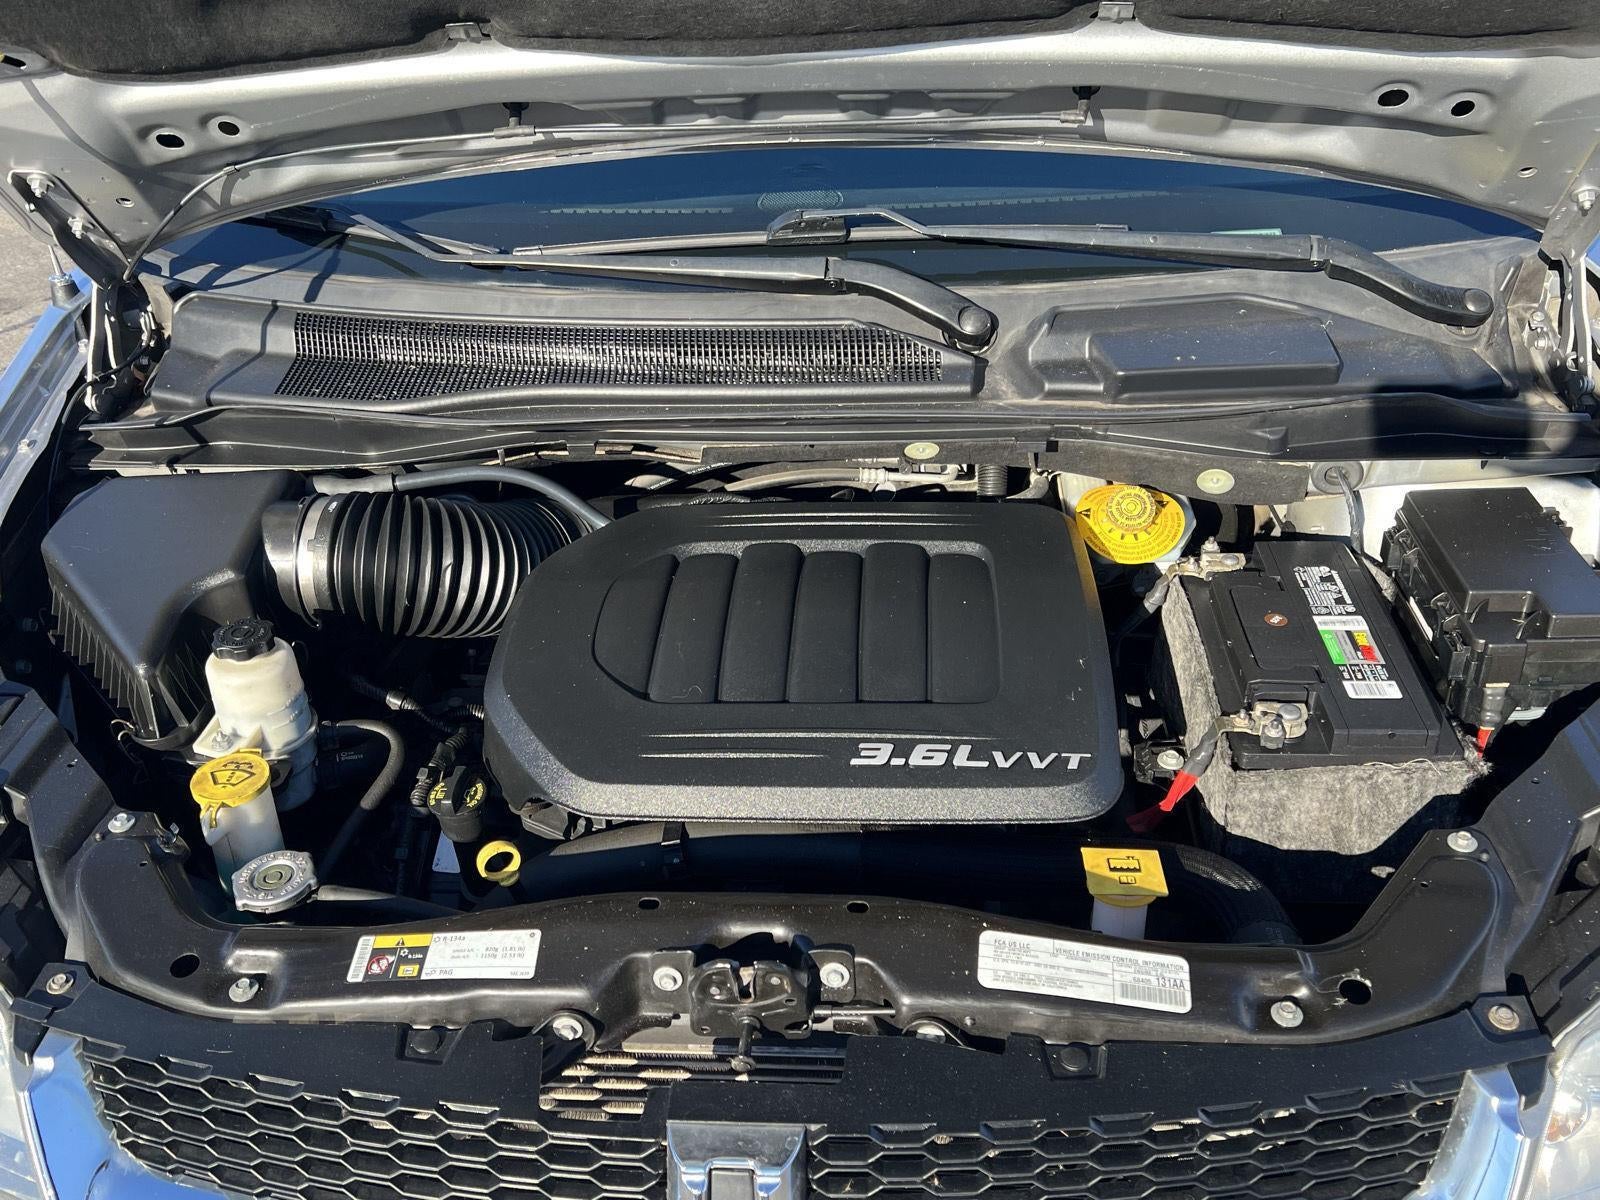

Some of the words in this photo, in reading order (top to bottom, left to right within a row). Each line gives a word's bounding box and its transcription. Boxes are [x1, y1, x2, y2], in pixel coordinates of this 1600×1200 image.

[849, 742, 990, 767] 3.6L
[992, 750, 1092, 770] VVT
[1055, 947, 1080, 957] VEHICLE
[1081, 950, 1111, 961] EMISSION
[1112, 955, 1140, 966] CONTROL
[1142, 959, 1184, 971] INFORMATION
[1156, 977, 1185, 990] 131AA
